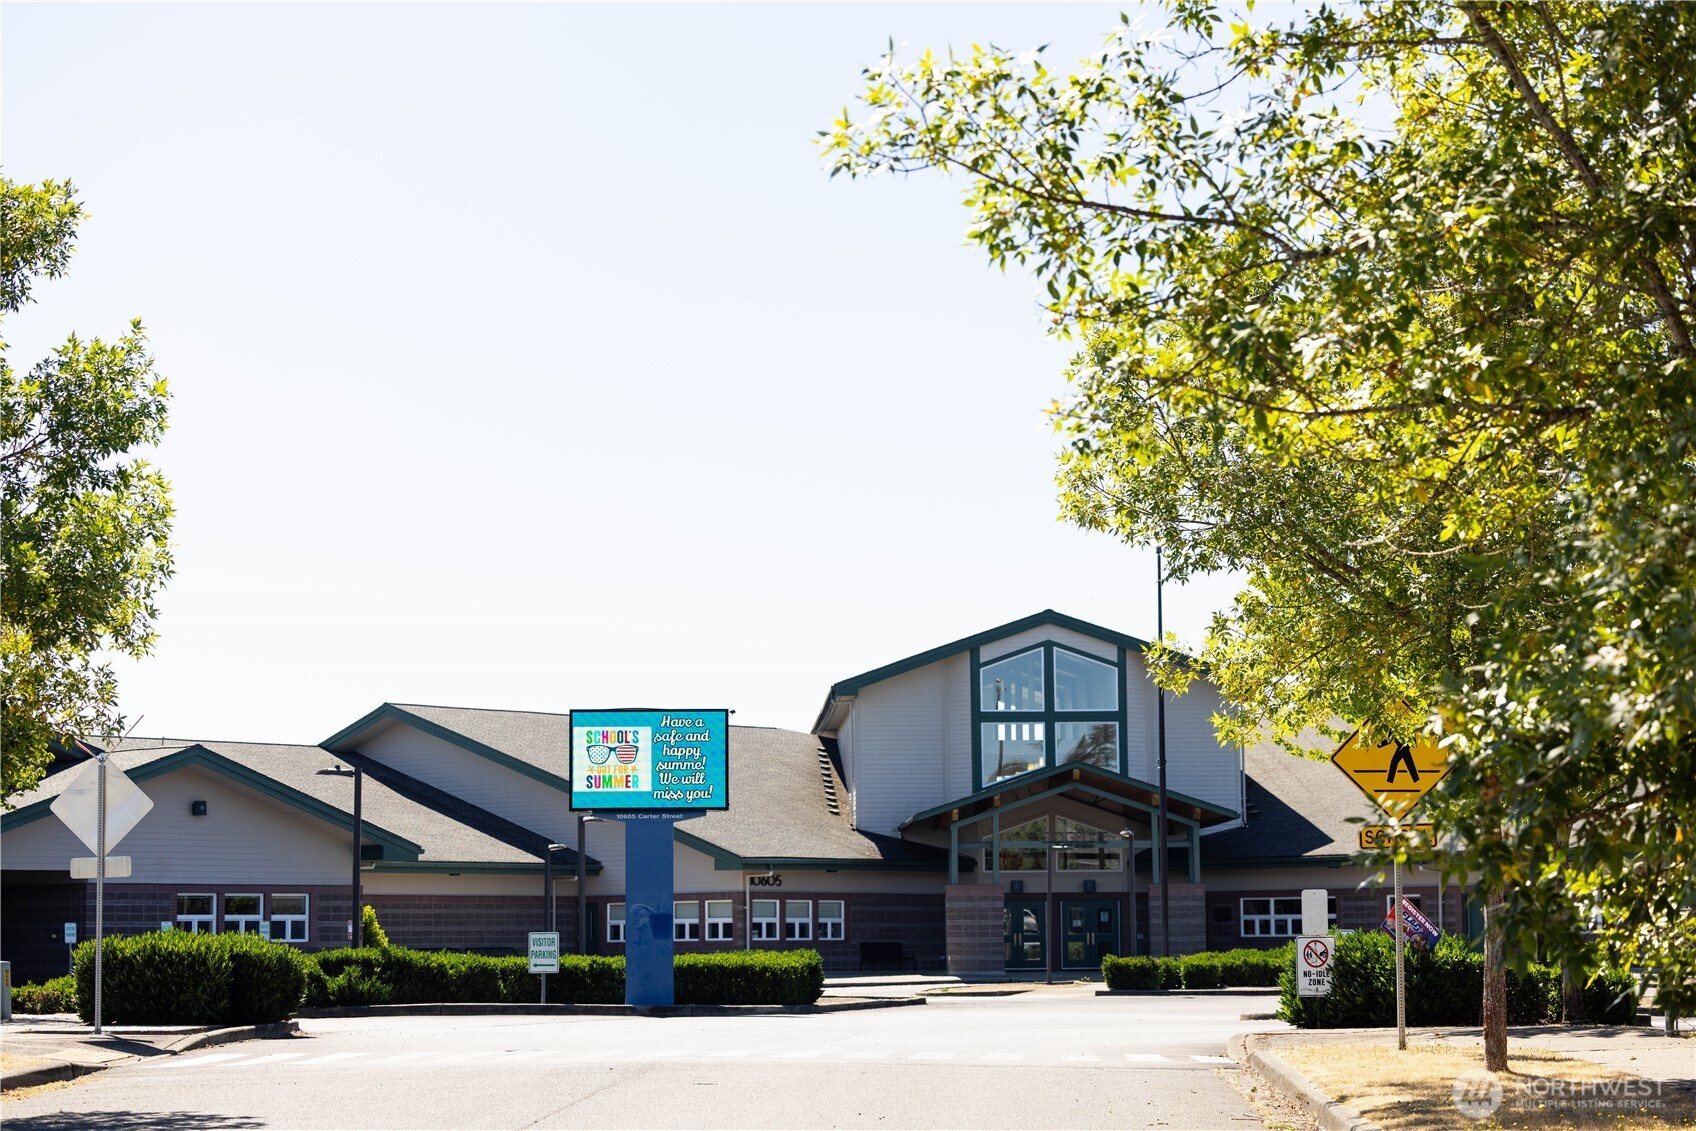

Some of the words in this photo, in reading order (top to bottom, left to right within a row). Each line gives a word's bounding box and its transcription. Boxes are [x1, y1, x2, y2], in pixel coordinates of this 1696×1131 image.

[660, 715, 693, 727] Have
[694, 718, 705, 727] a
[586, 730, 639, 744] SCHOOL'S
[653, 730, 684, 745] safe
[685, 729, 711, 742] and
[662, 743, 701, 760] happy
[596, 765, 611, 774] OUT
[613, 765, 629, 774] FOR
[656, 757, 707, 771] summe!
[586, 775, 639, 789] SUMMER
[659, 772, 680, 785] We
[681, 772, 706, 785] will
[653, 787, 684, 800] miss
[685, 785, 714, 803] you!
[750, 874, 782, 887] 10605
[1402, 899, 1426, 924] REGISTER
[1424, 921, 1439, 937] NOW
[531, 937, 556, 947] VISITOR
[531, 949, 557, 959] PARKING
[1303, 970, 1330, 978] NO-IDLE
[1308, 978, 1326, 986] ZONE
